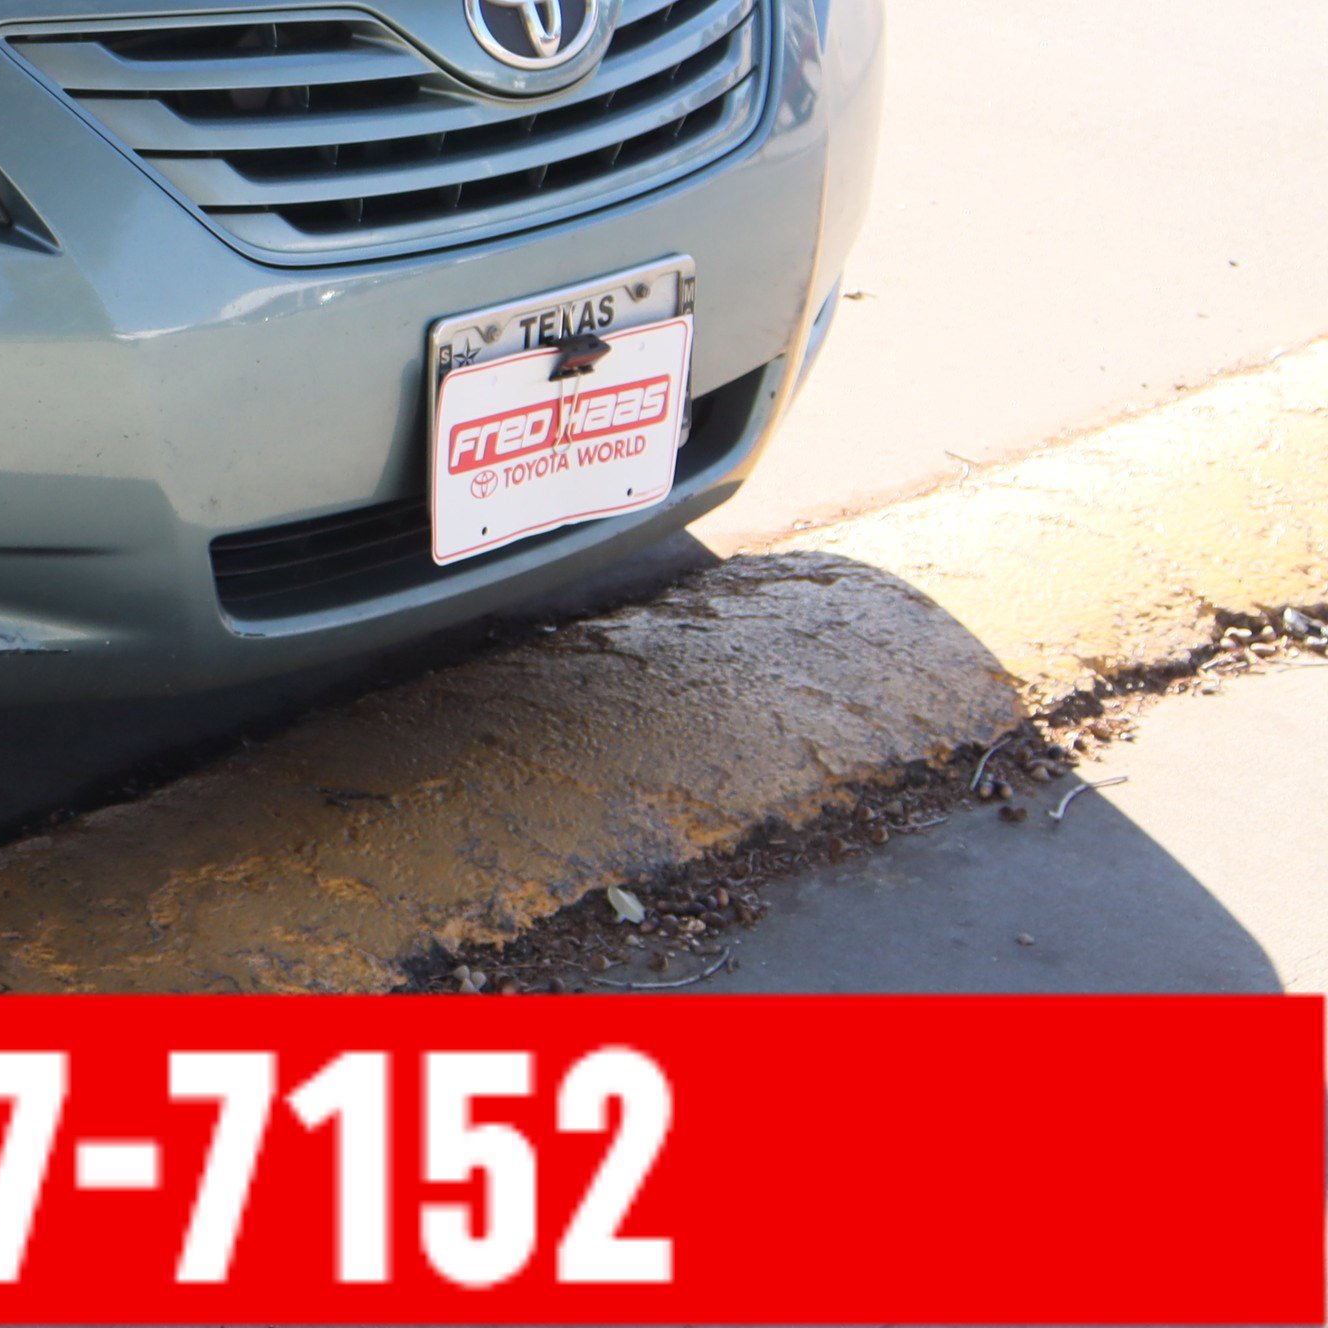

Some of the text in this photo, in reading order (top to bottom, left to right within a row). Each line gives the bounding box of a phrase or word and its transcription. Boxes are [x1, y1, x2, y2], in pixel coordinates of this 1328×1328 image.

[519, 294, 615, 350] TEXAS
[503, 435, 647, 489] TOYOTA WORLD
